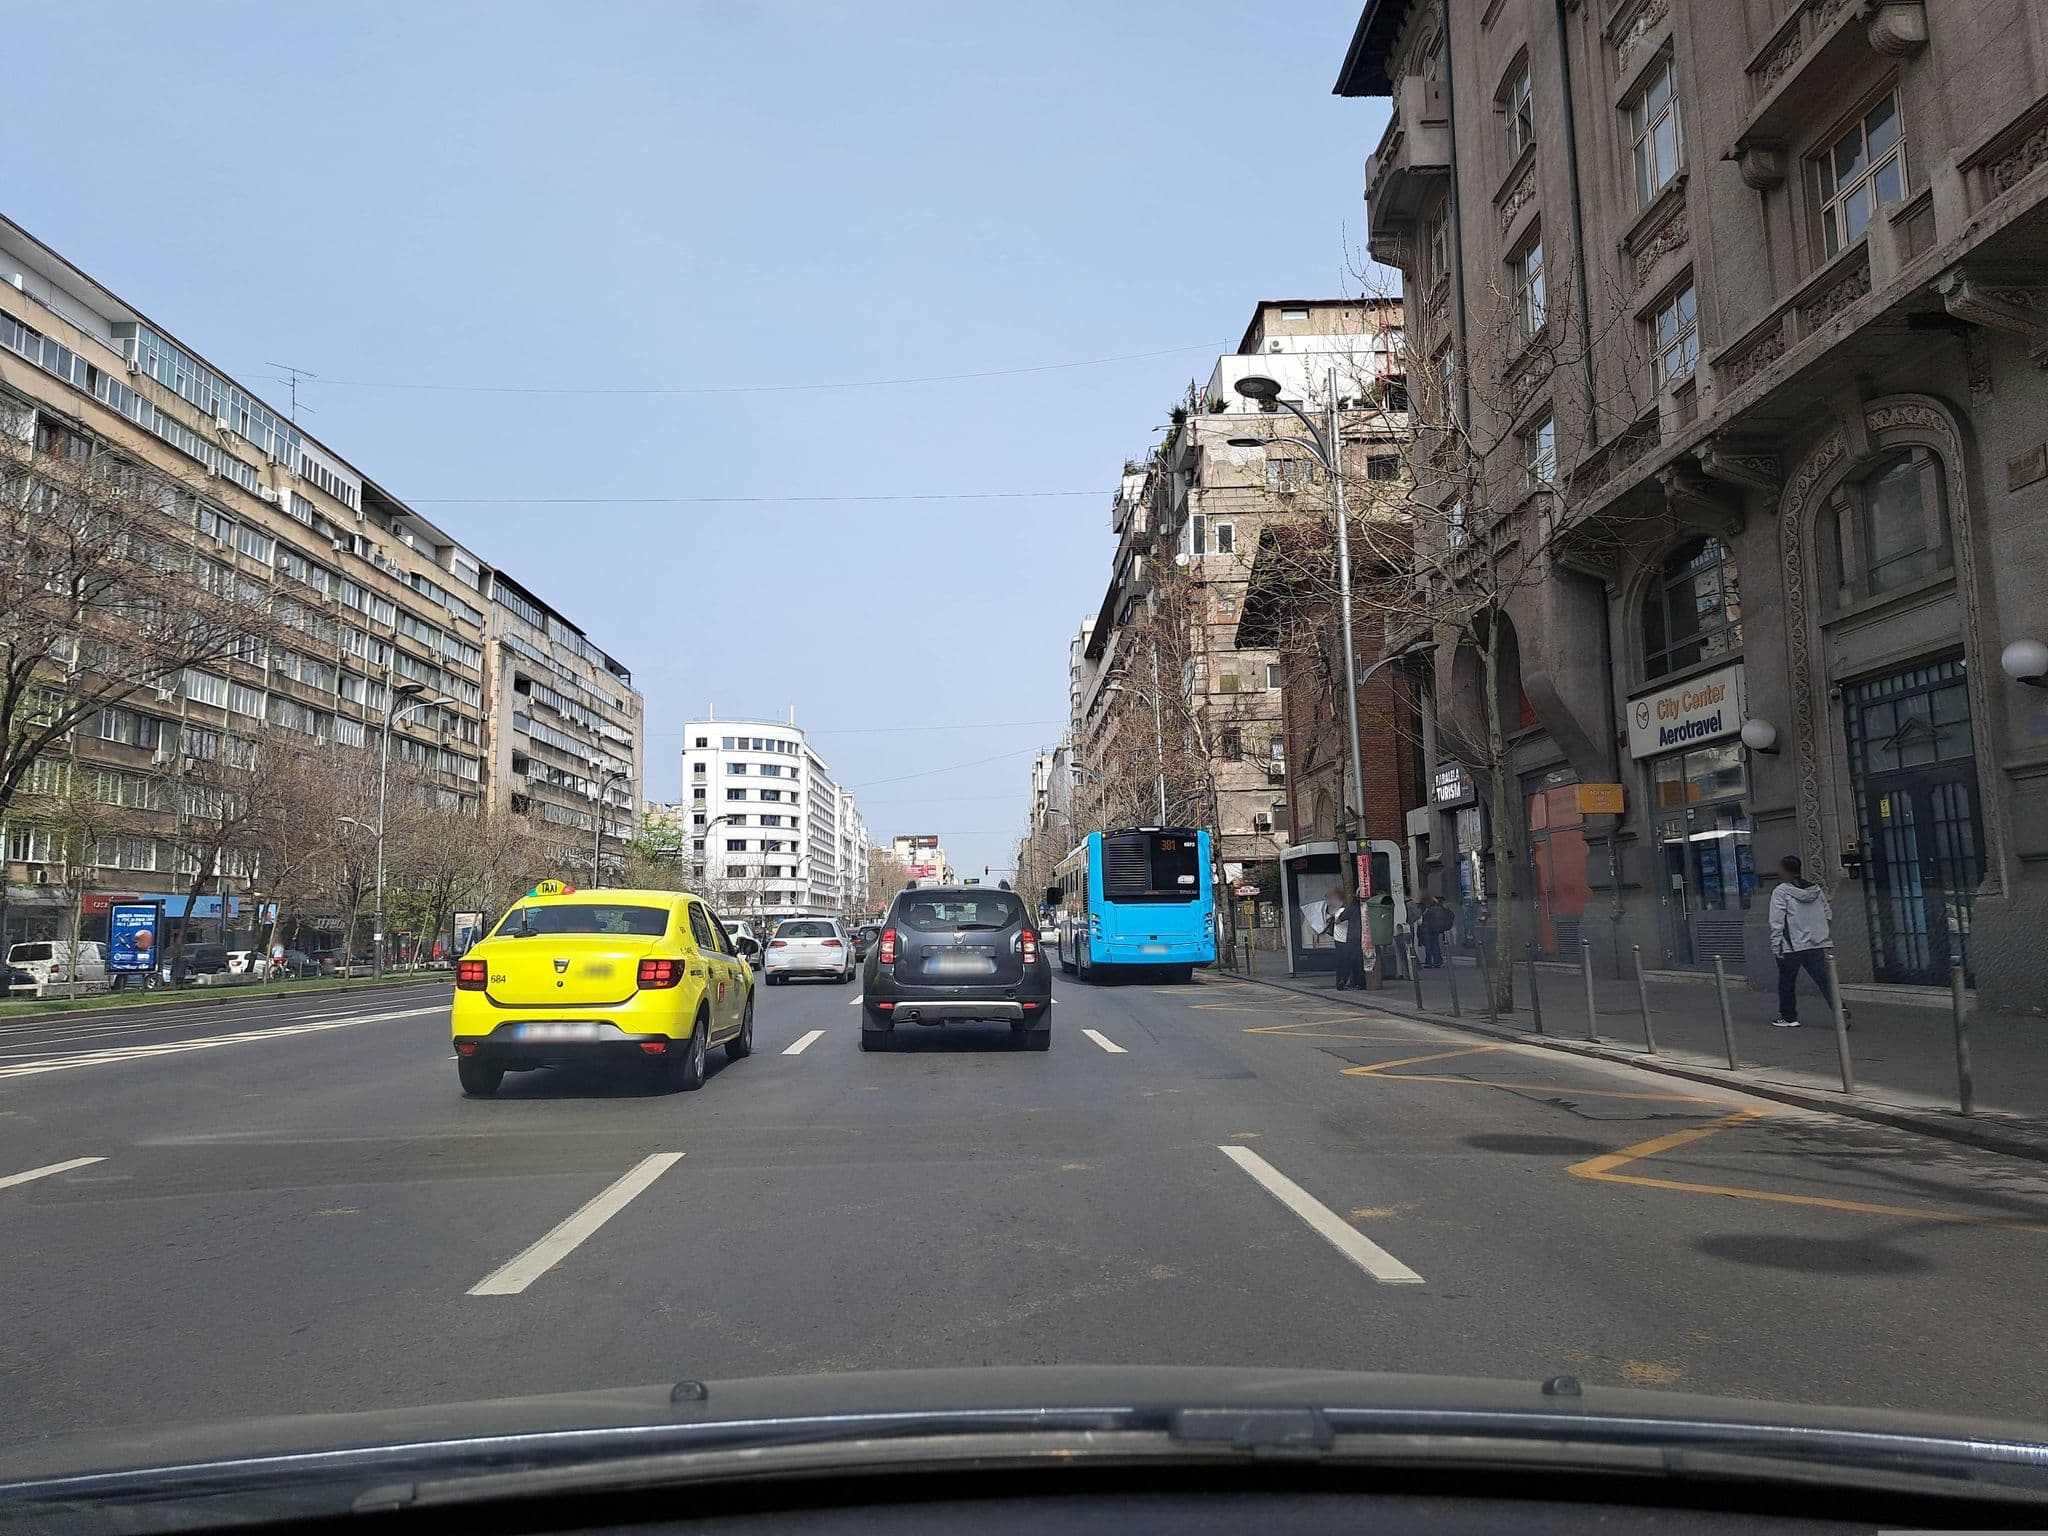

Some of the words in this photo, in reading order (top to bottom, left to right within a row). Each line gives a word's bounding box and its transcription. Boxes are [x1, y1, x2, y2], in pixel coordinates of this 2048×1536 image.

[1656, 698, 1680, 721] City
[1682, 684, 1726, 713] Center
[1659, 709, 1723, 747] Aerotravel
[1436, 781, 1462, 803] TURISM
[1161, 839, 1176, 851] 381
[542, 881, 559, 894] TAXI
[490, 974, 507, 984] 684
